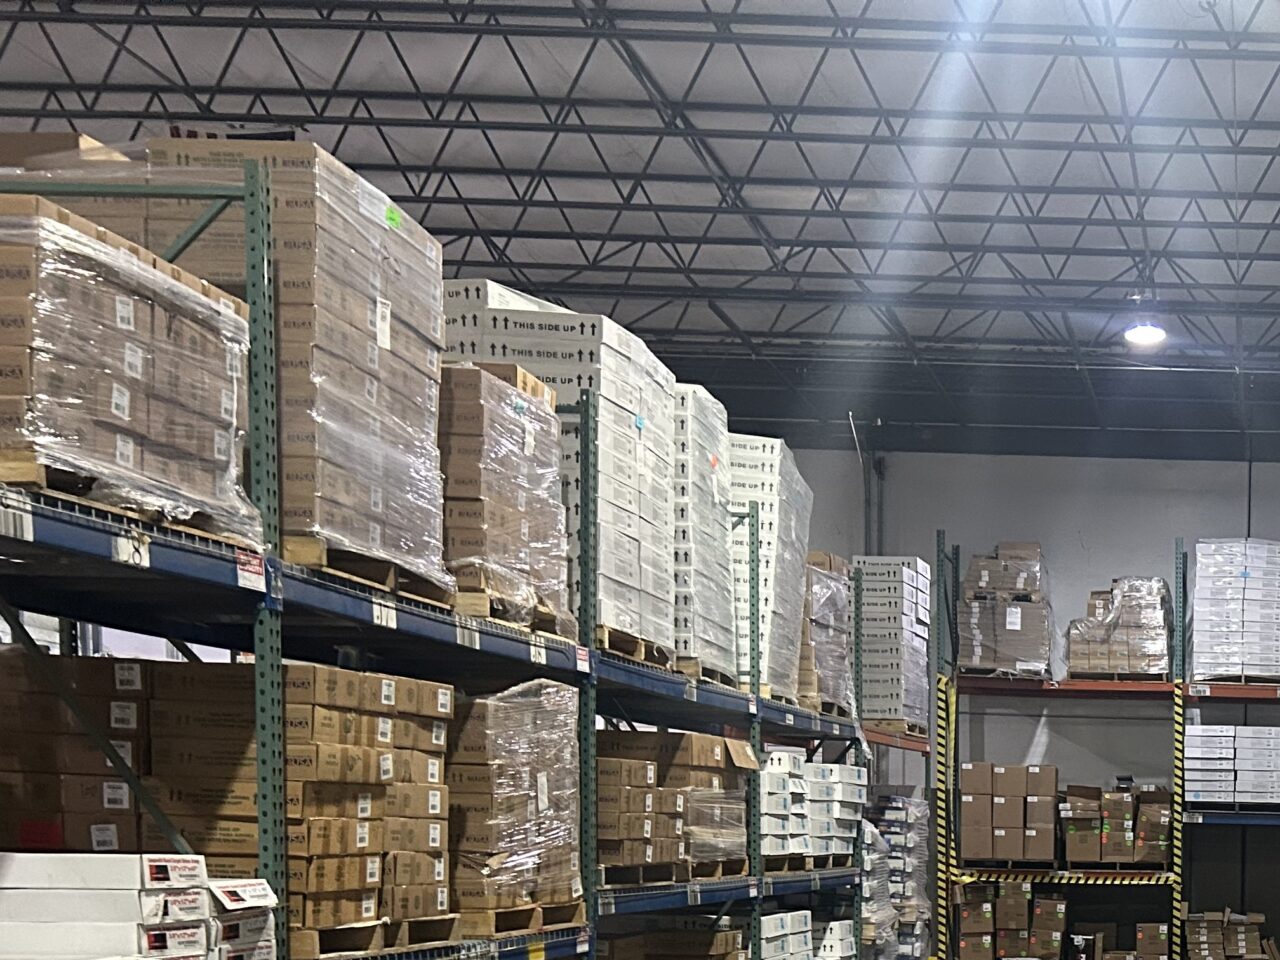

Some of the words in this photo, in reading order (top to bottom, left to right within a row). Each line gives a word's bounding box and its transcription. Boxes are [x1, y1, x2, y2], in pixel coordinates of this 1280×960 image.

[448, 290, 461, 298] UP
[513, 321, 535, 330] THIS
[538, 323, 560, 332] SIDE
[563, 325, 576, 333] UP
[511, 348, 533, 357] THIS
[536, 350, 558, 359] SIDE
[561, 352, 574, 360] UP
[561, 376, 573, 384] UP
